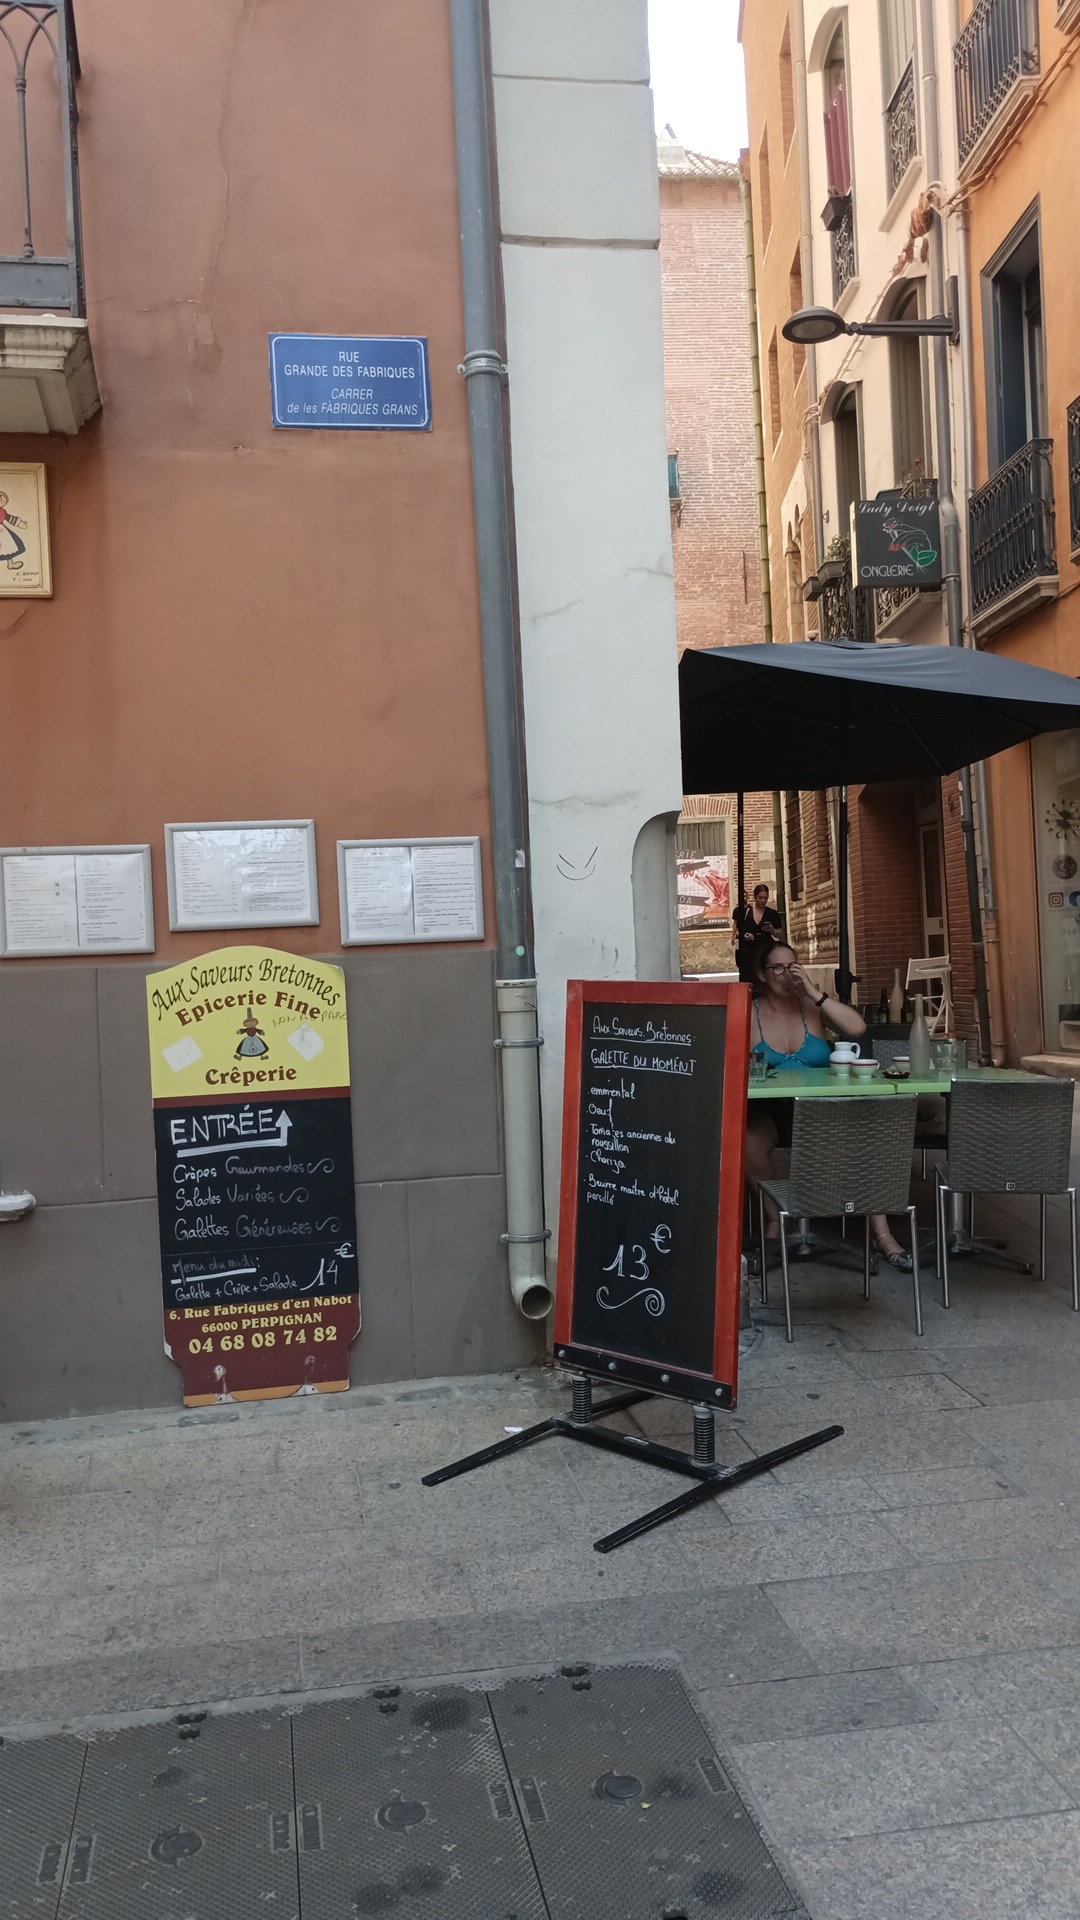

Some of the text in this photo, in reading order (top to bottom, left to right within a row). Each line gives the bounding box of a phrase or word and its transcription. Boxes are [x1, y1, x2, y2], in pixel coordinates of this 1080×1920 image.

[339, 351, 360, 363] RUE
[284, 364, 415, 379] GRANDE DES FABRIQUES
[331, 388, 373, 400] CARRER
[287, 402, 299, 414] de
[303, 402, 317, 414] les
[382, 403, 418, 416] GRANS
[858, 502, 892, 517] Lady
[860, 564, 914, 578] ONGLERIE
[152, 958, 341, 1021] Aux Saveurs Bretonnes
[175, 989, 321, 1026] Epicerie Fine
[592, 1015, 610, 1034] Aux
[590, 1048, 629, 1065] GALETTE
[633, 1055, 647, 1068] DU
[205, 1065, 298, 1087] Crêperie
[590, 1078, 636, 1100] emmental
[588, 1098, 613, 1124] Oeuf
[170, 1104, 277, 1145] ENTRÉE
[591, 1137, 630, 1154] roussillon
[626, 1131, 662, 1142] anciennes
[664, 1131, 676, 1144] du
[225, 1156, 305, 1175] Gourmandes
[588, 1173, 617, 1191] Beurre
[175, 1186, 222, 1211] Salades
[174, 1214, 230, 1241] Galettes
[172, 1258, 206, 1286] Menu
[209, 1257, 226, 1273] du
[174, 1283, 211, 1302] Galette
[259, 1271, 298, 1292] Salade
[184, 1308, 210, 1319] Rue
[214, 1302, 279, 1317] Fabriques
[314, 1295, 352, 1307] Nabot
[201, 1312, 322, 1334] 66000 PERPIGNAN
[189, 1326, 337, 1354] 04 68 08 74 82
